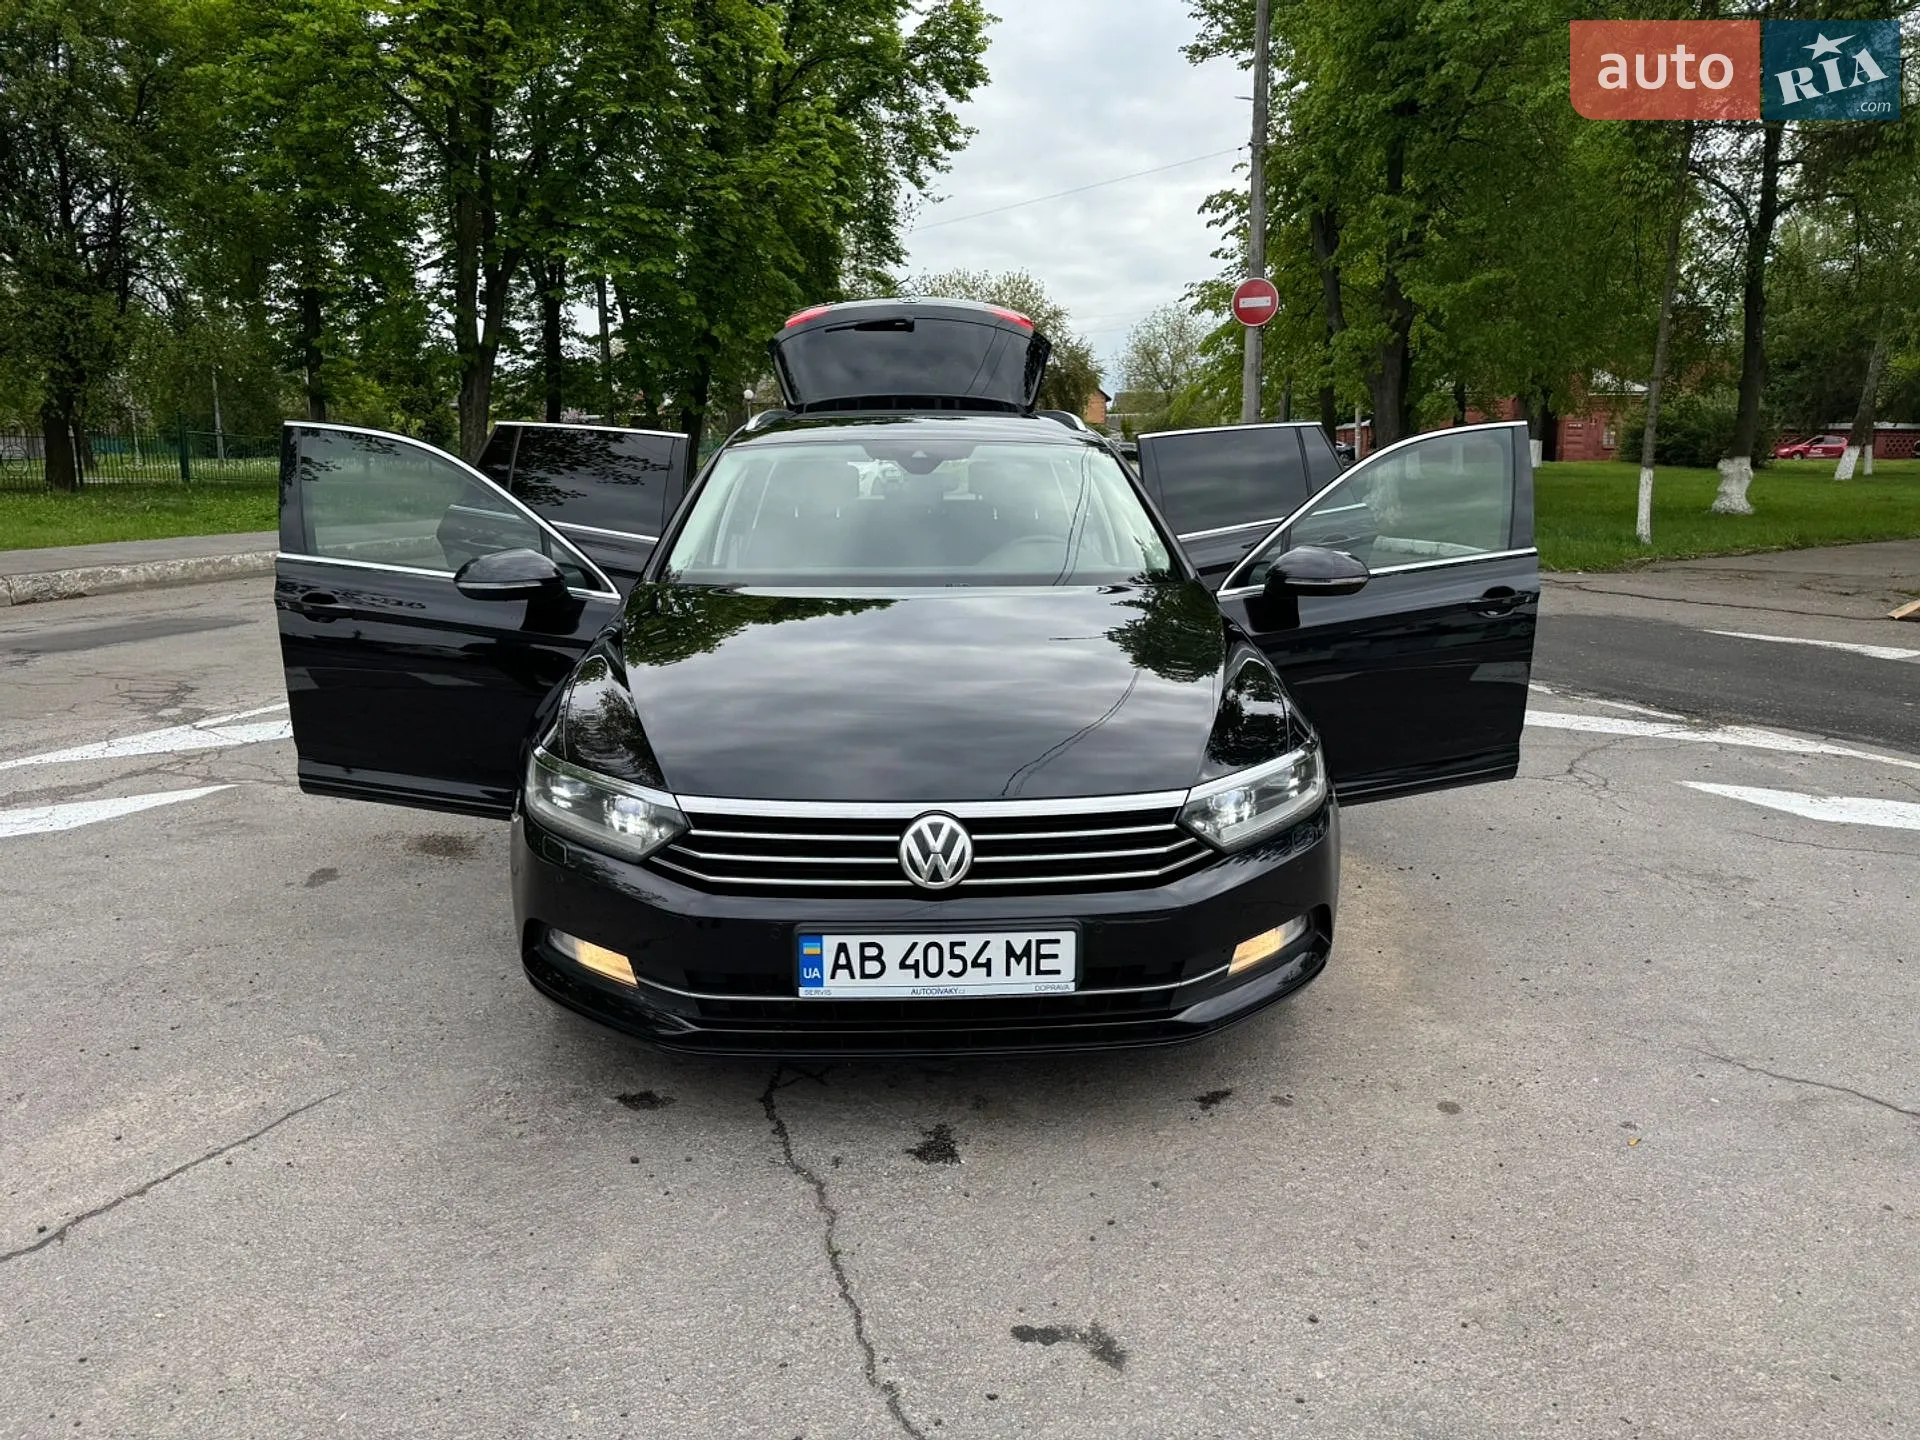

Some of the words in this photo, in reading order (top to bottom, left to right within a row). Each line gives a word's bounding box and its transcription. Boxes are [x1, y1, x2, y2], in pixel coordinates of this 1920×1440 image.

[830, 942, 886, 979] AB
[899, 940, 992, 978] 4054
[1005, 939, 1061, 977] ME
[803, 967, 821, 979] UA
